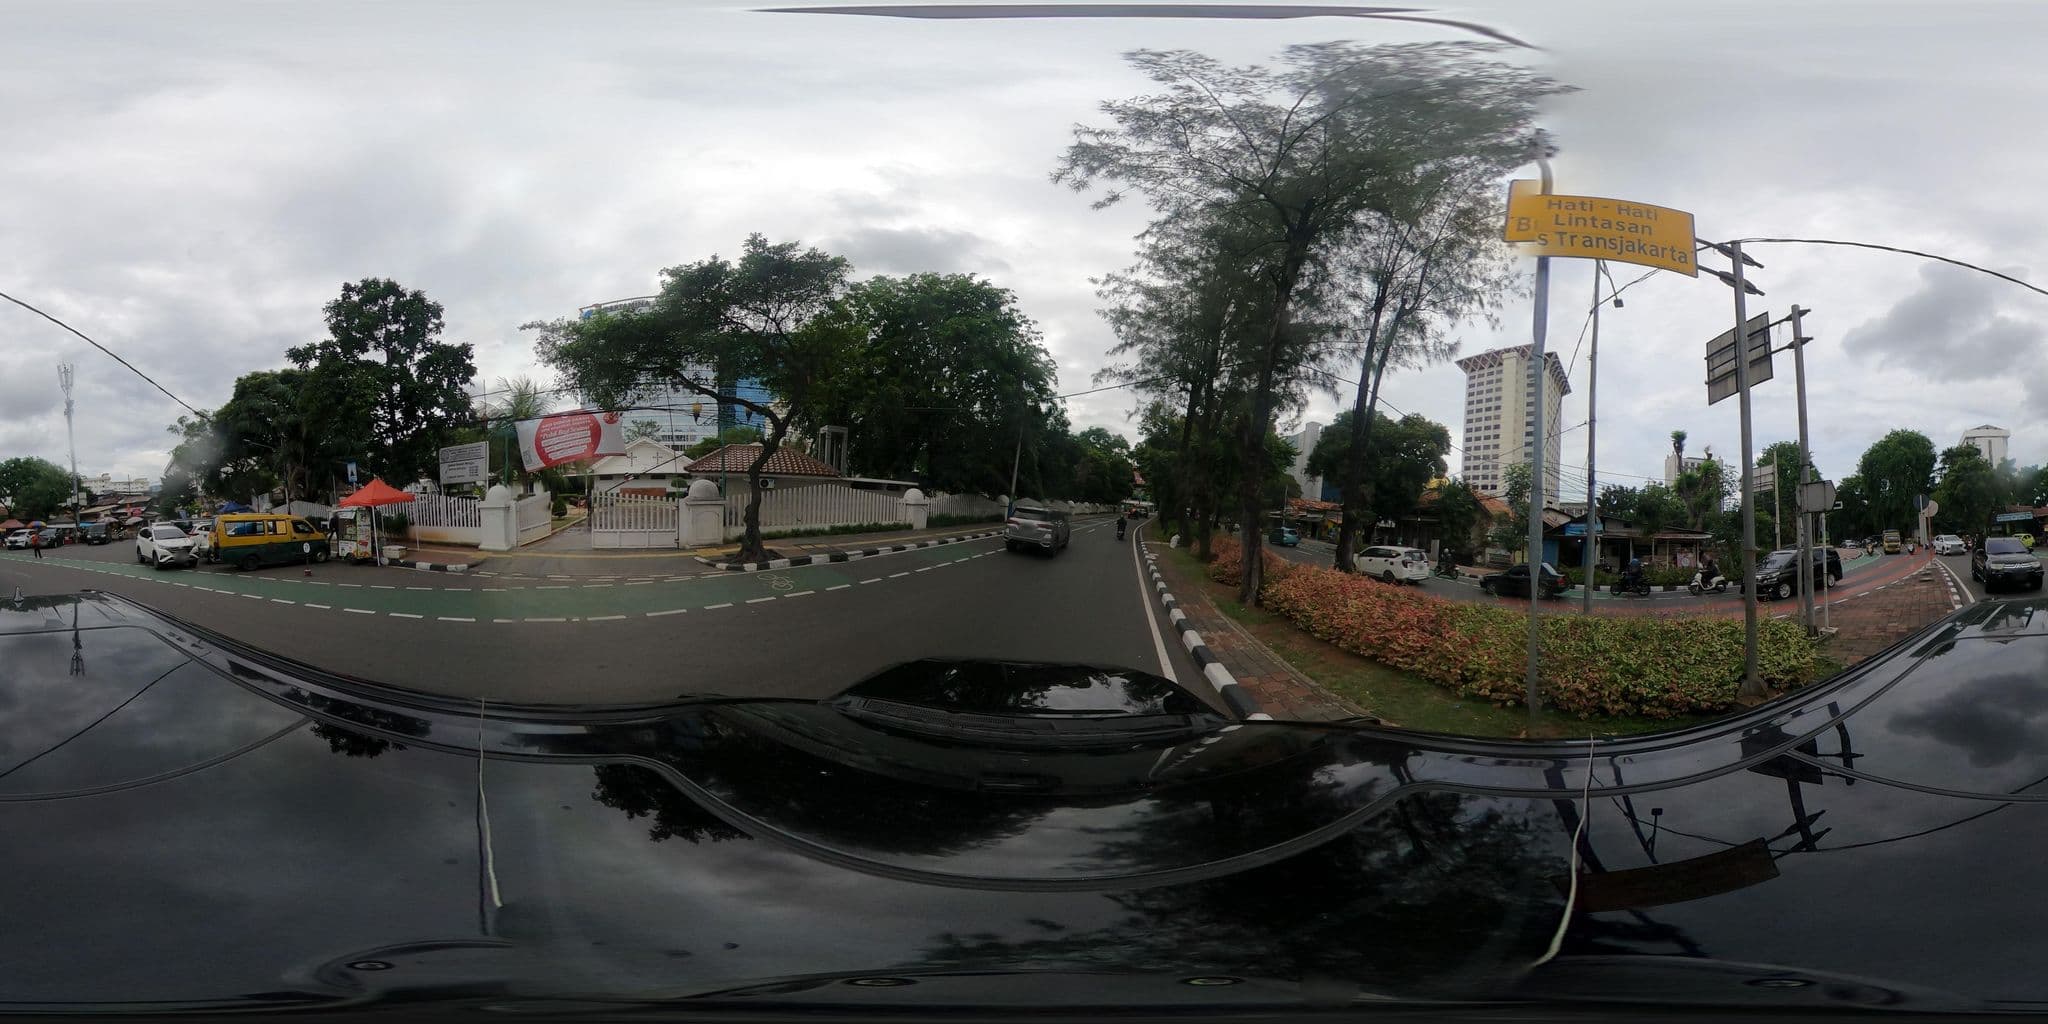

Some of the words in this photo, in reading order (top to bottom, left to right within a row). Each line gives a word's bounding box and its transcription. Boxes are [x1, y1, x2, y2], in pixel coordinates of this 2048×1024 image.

[1547, 199, 1593, 212] Hati
[1616, 204, 1658, 220] Hati
[1554, 213, 1652, 236] Lintasan
[1554, 231, 1688, 264] Transjakarta
